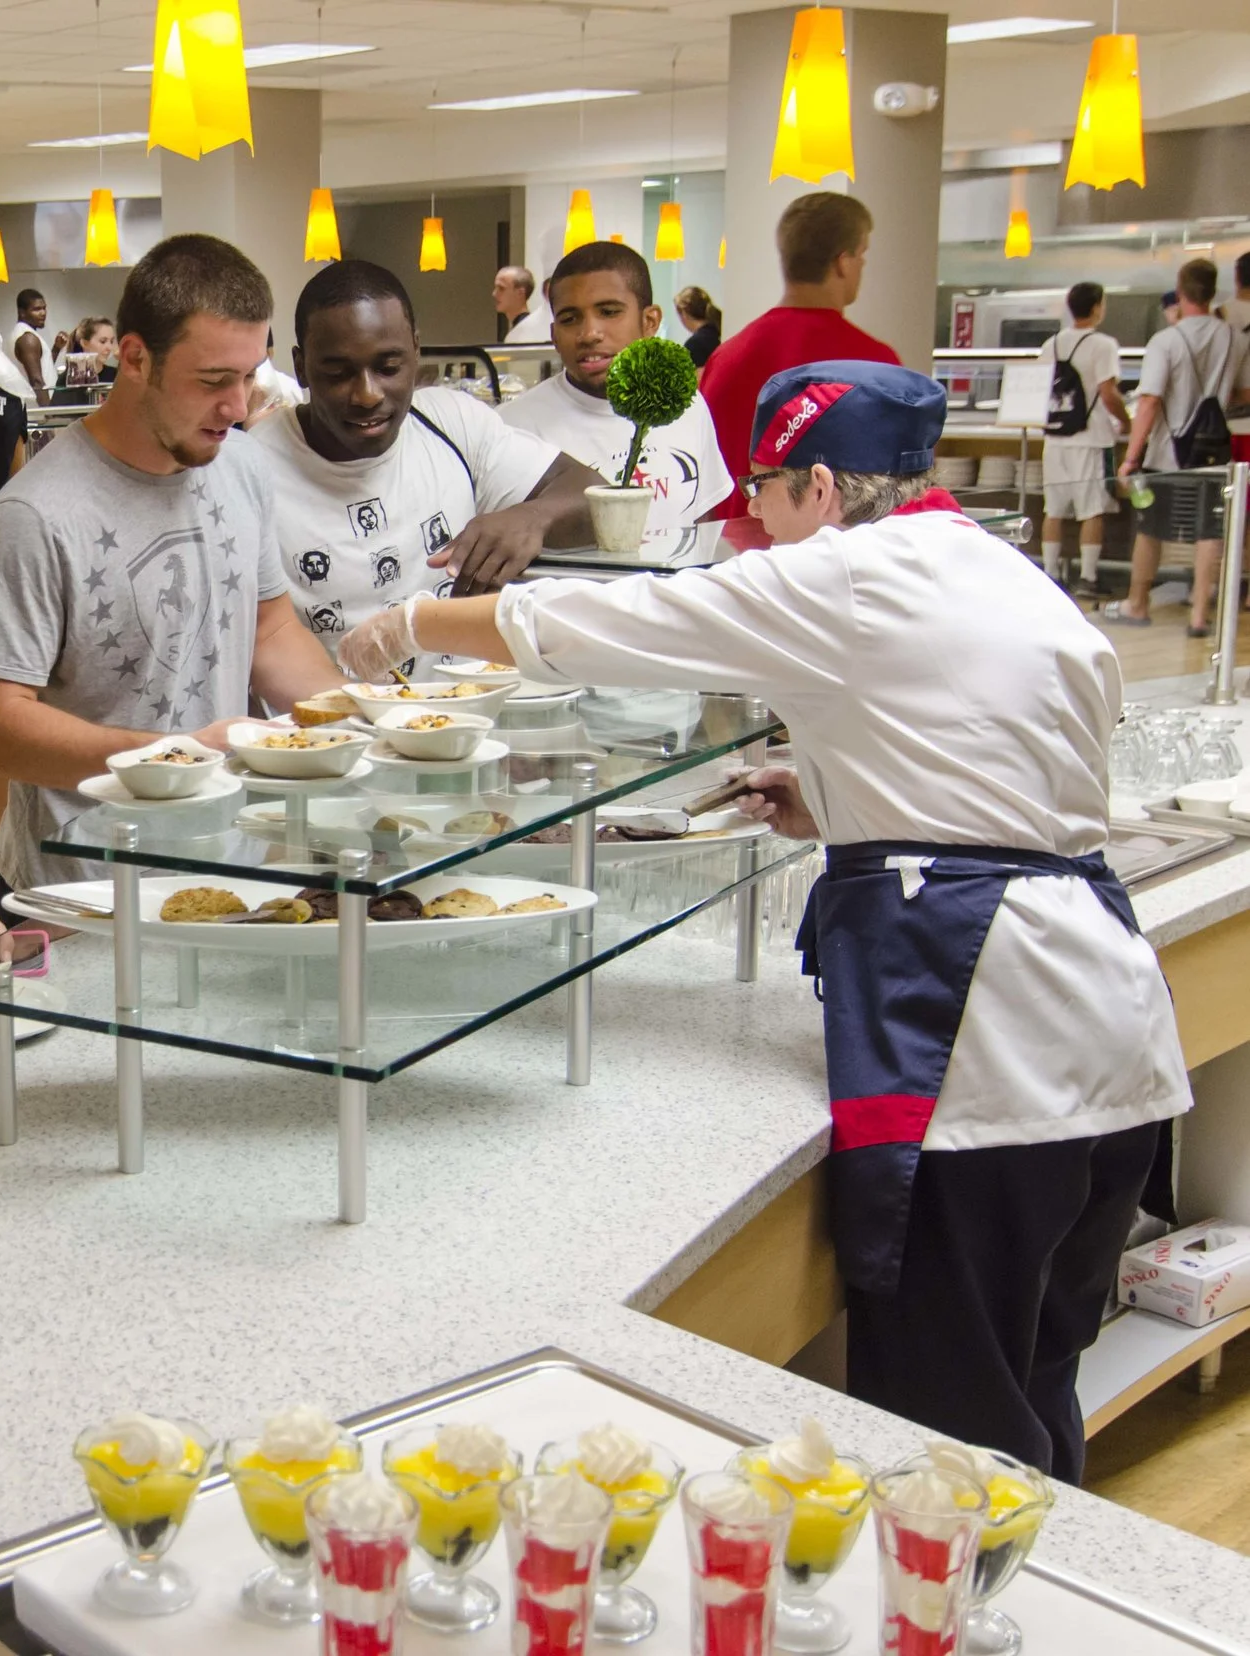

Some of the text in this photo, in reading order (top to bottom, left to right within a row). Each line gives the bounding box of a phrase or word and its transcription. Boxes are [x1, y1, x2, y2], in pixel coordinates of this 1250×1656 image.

[774, 396, 818, 453] sodexo
[1121, 1268, 1159, 1287] SYSCO
[1203, 1271, 1232, 1306] SYSCO
